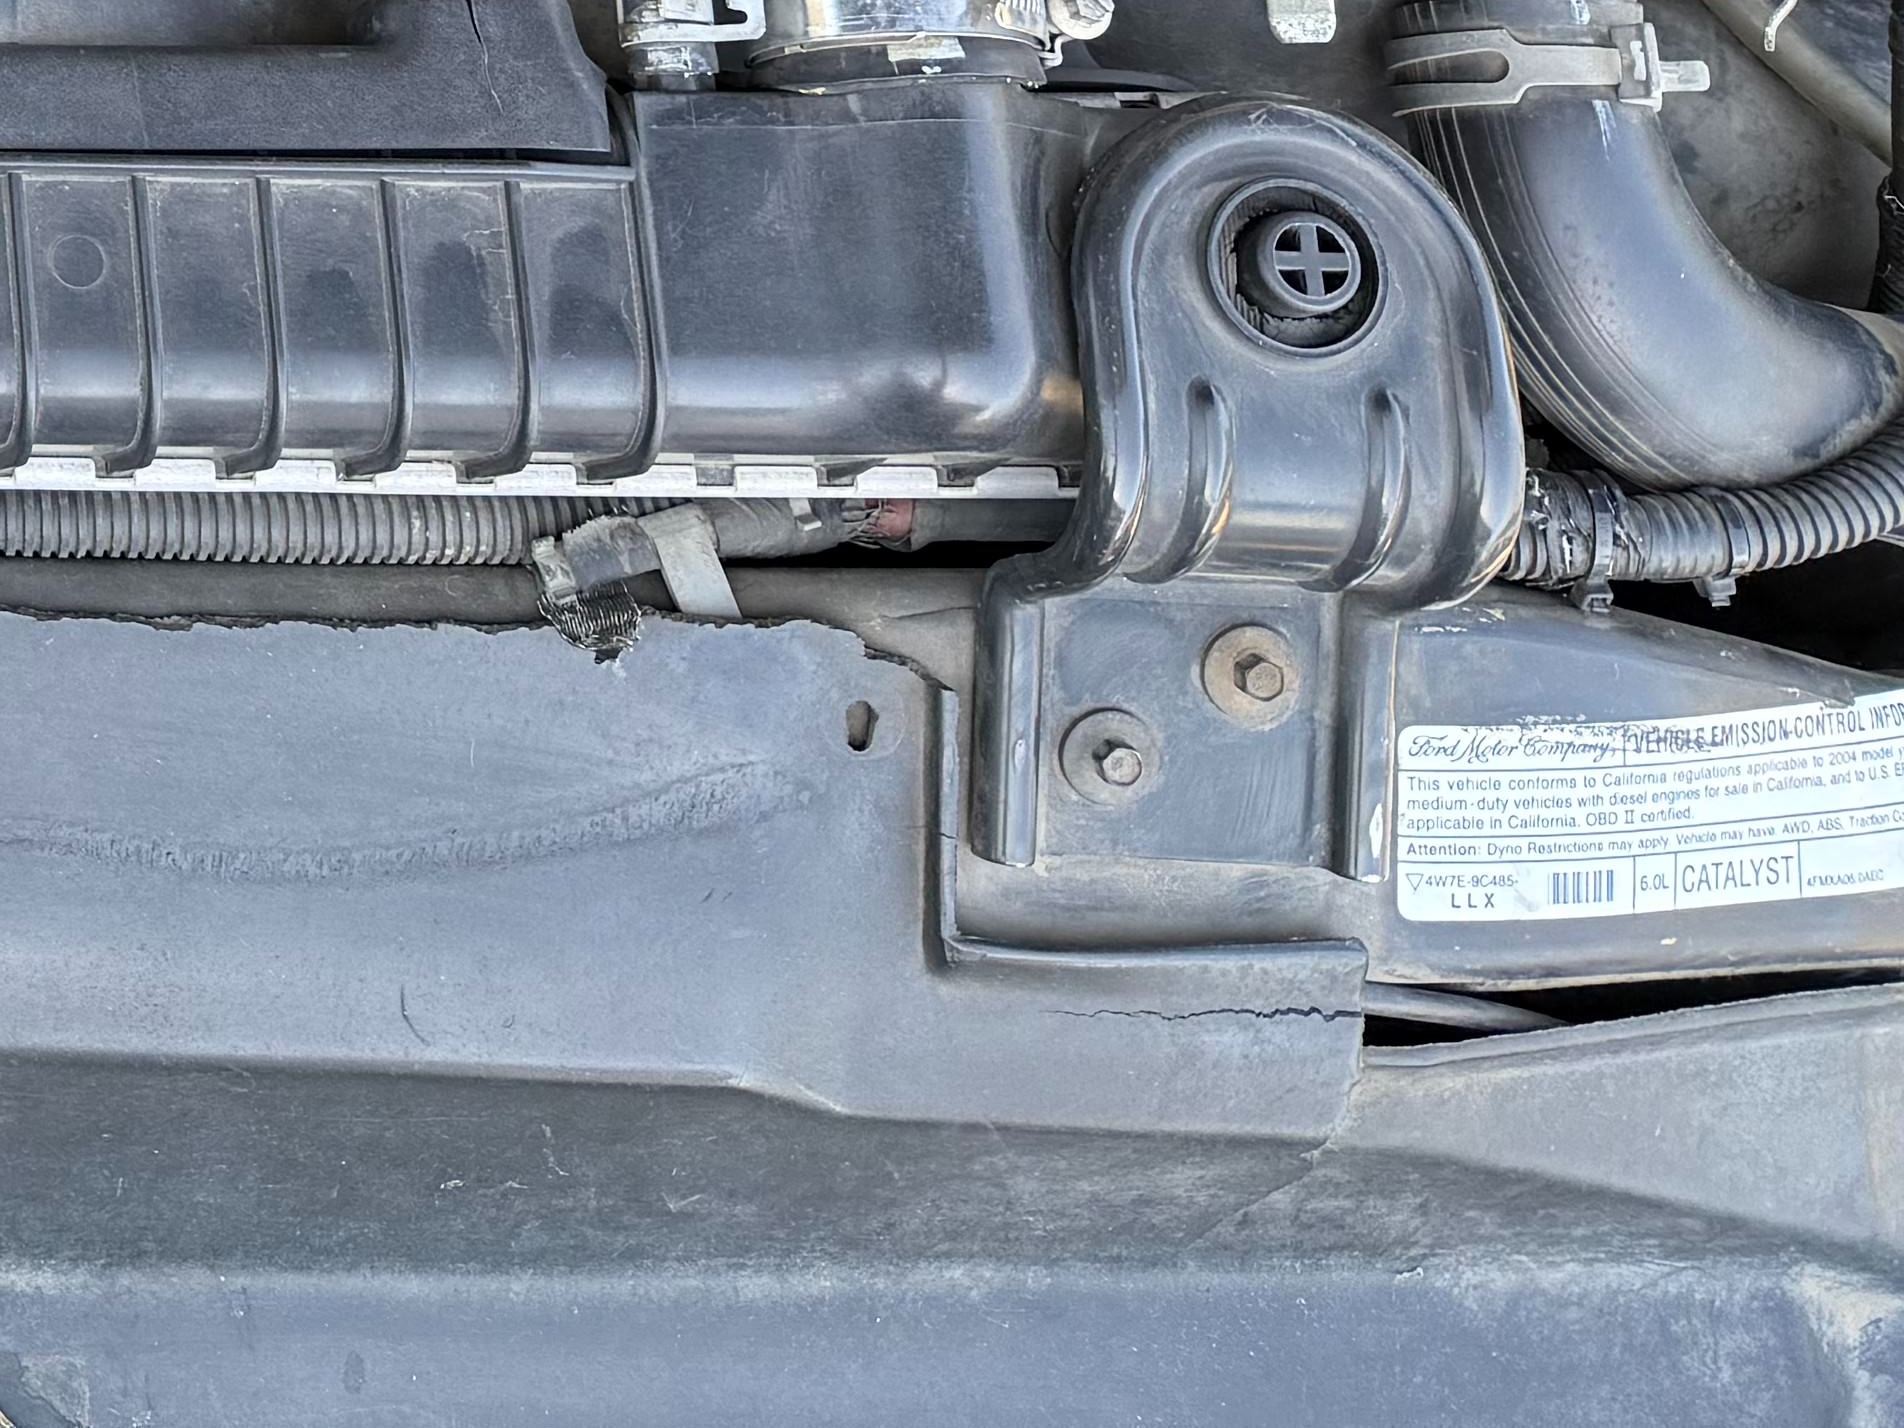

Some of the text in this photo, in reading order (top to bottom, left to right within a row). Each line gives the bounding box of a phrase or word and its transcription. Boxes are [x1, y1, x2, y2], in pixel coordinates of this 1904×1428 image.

[1409, 735, 1460, 757] Ford
[1451, 732, 1518, 764] Motor
[1628, 725, 1706, 753] VEHICLE
[1407, 747, 1893, 792] This vehicle conforms to California regulations applicable to 2004 model
[1514, 794, 1573, 810] vehicles
[1577, 793, 1604, 808] with
[1609, 791, 1647, 806] diesel
[1651, 788, 1700, 807] engines
[1704, 785, 1720, 798] for
[1724, 782, 1749, 797] sale
[1752, 780, 1763, 793] in
[1830, 771, 1851, 785] and
[1854, 769, 1865, 782] to
[1406, 815, 1484, 831] applicable
[1490, 816, 1503, 829] in
[1585, 812, 1618, 827] OBD
[1623, 810, 1635, 824] II
[1406, 843, 1481, 857] Attention:
[1487, 842, 1522, 859] Dyno
[1527, 840, 1604, 855] Restrictions
[1607, 840, 1633, 854] may
[1675, 830, 1717, 846] Vehicle
[1720, 827, 1743, 842] may
[1849, 812, 1890, 828] Traction
[1640, 874, 1669, 892] 6.0L
[1682, 856, 1794, 893] CATALYST
